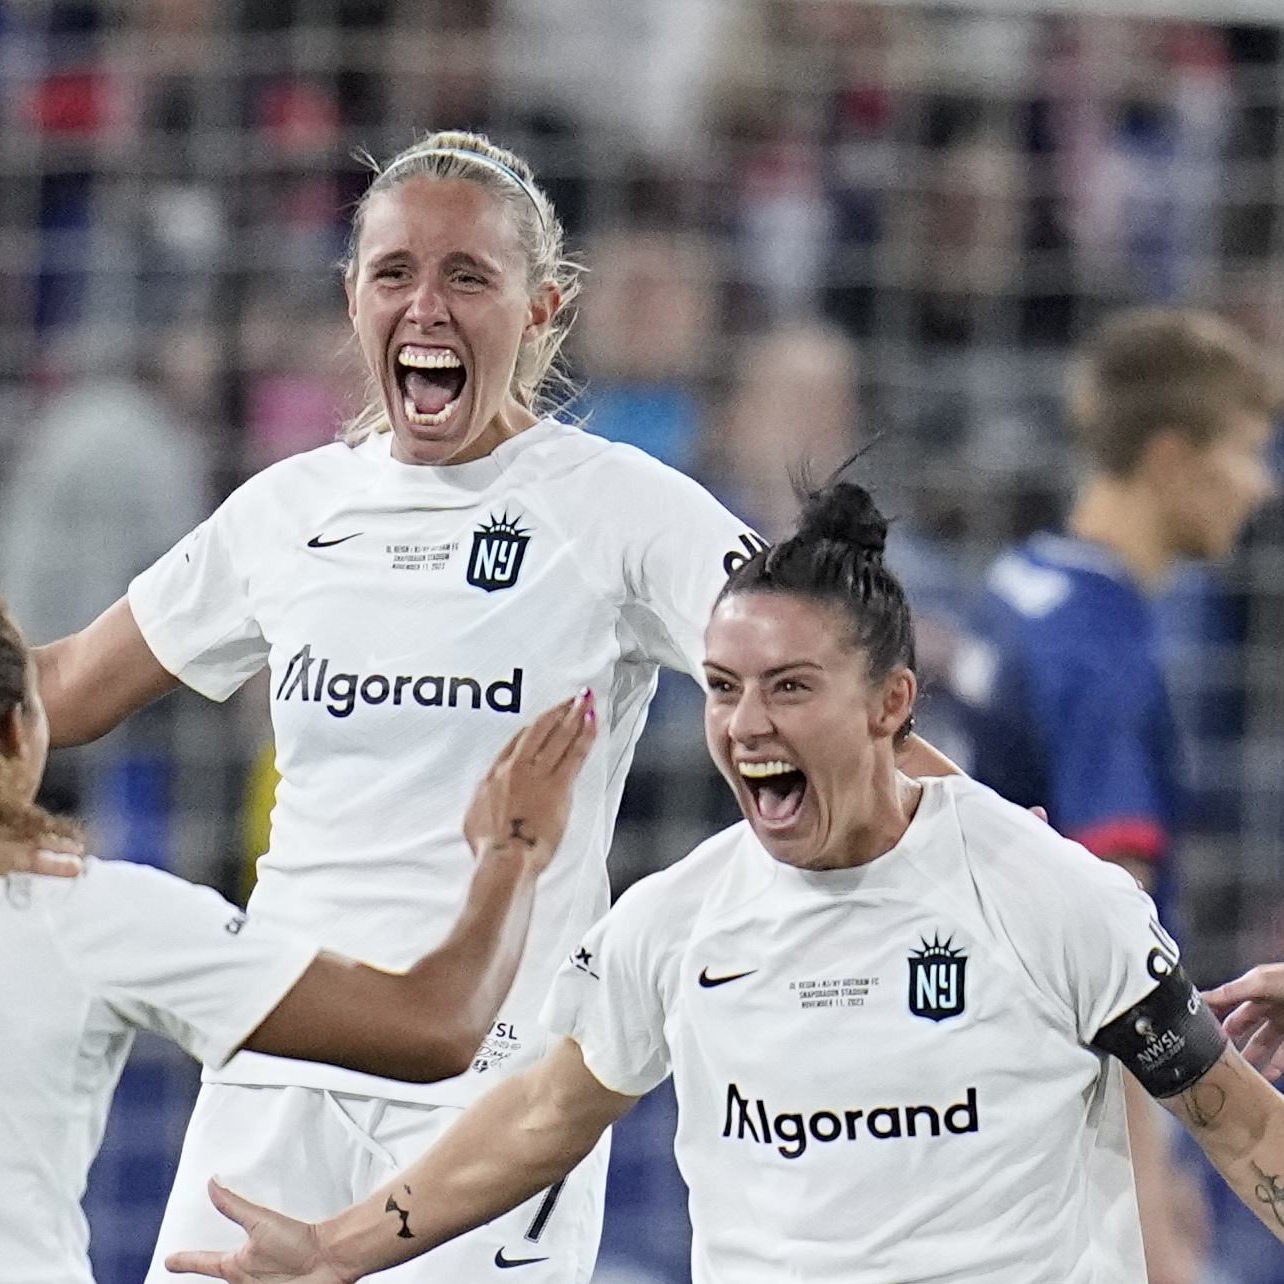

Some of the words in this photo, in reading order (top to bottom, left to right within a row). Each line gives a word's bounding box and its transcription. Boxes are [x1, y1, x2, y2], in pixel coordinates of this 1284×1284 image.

[473, 538, 519, 581] NY
[275, 643, 524, 719] Algorand
[916, 963, 958, 1010] NY
[722, 1083, 979, 1160] Algorand
